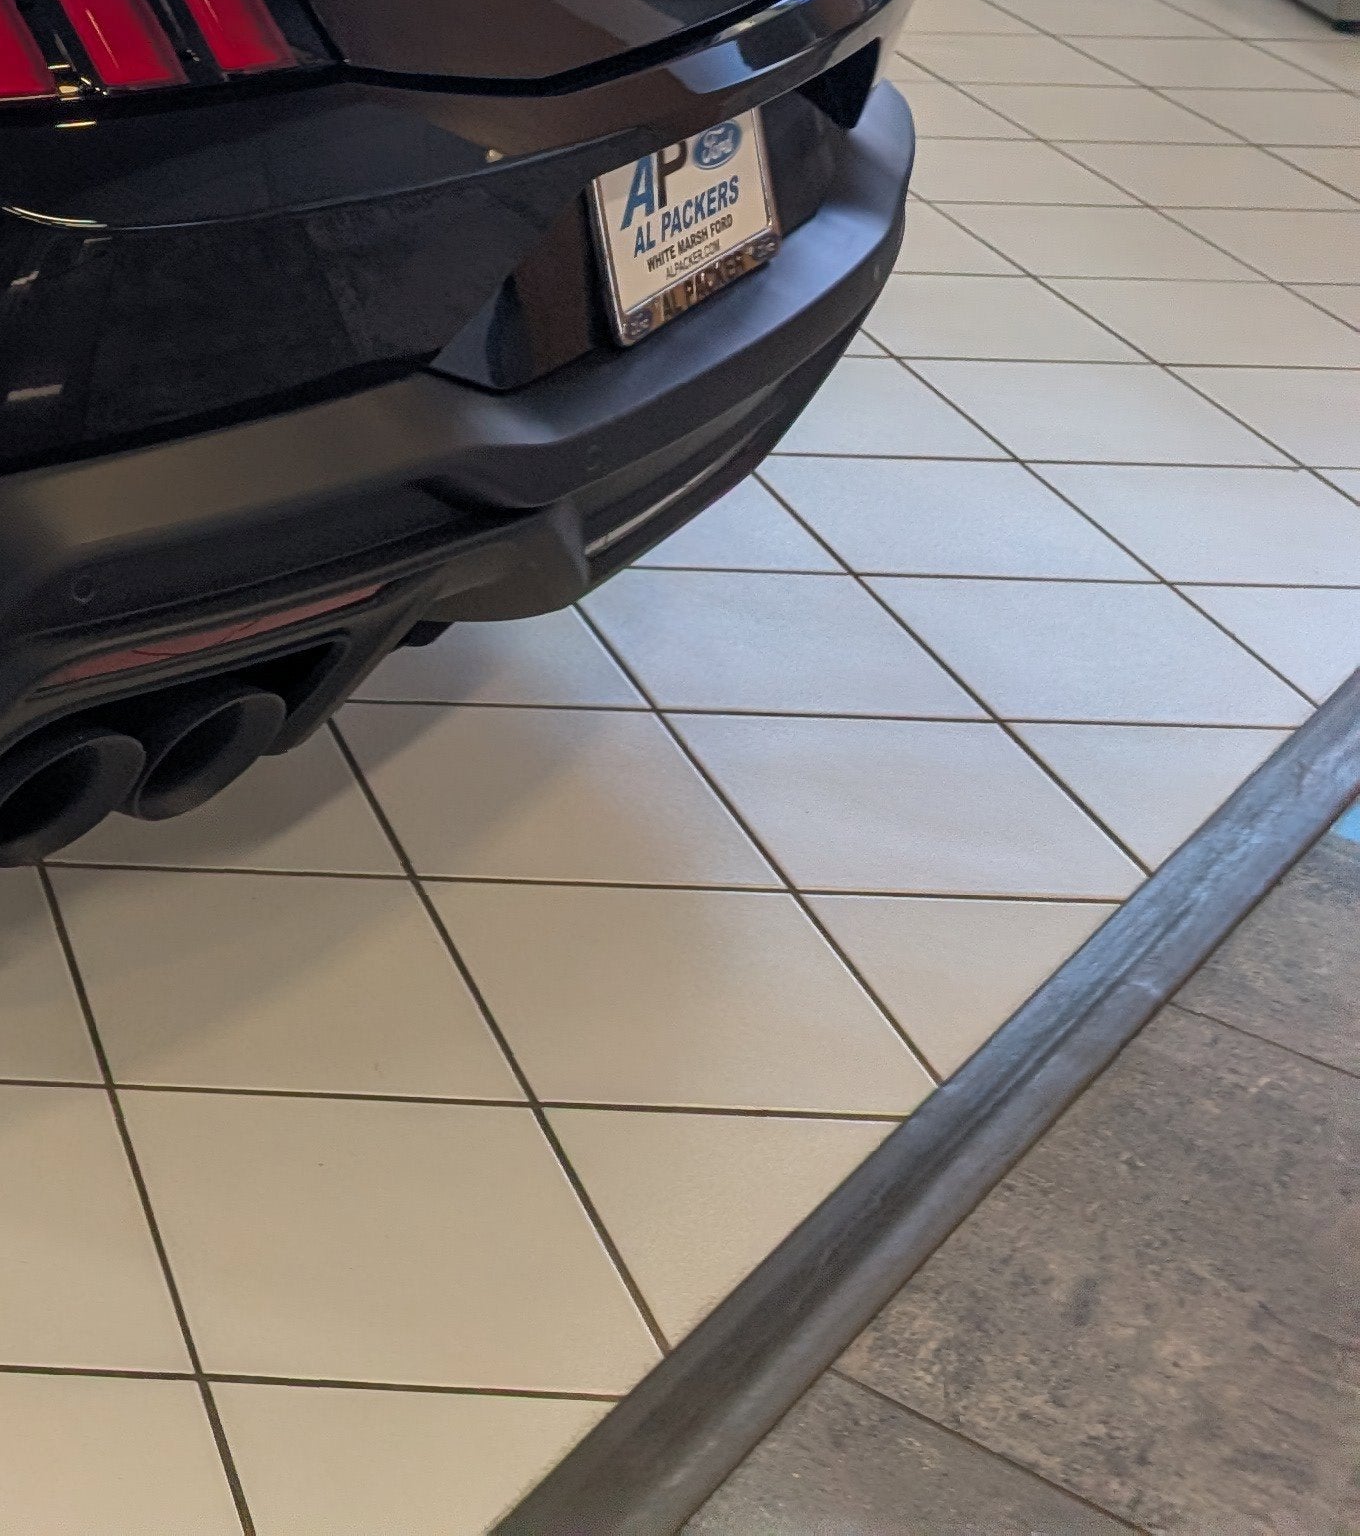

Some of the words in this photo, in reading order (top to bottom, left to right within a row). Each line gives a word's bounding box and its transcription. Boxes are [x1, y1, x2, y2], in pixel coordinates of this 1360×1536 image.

[620, 139, 688, 231] AP
[633, 221, 656, 258] AL
[661, 175, 740, 243] PACKERS
[646, 244, 676, 272] WHITE
[678, 226, 709, 260] MARSH
[710, 214, 734, 238] FORD
